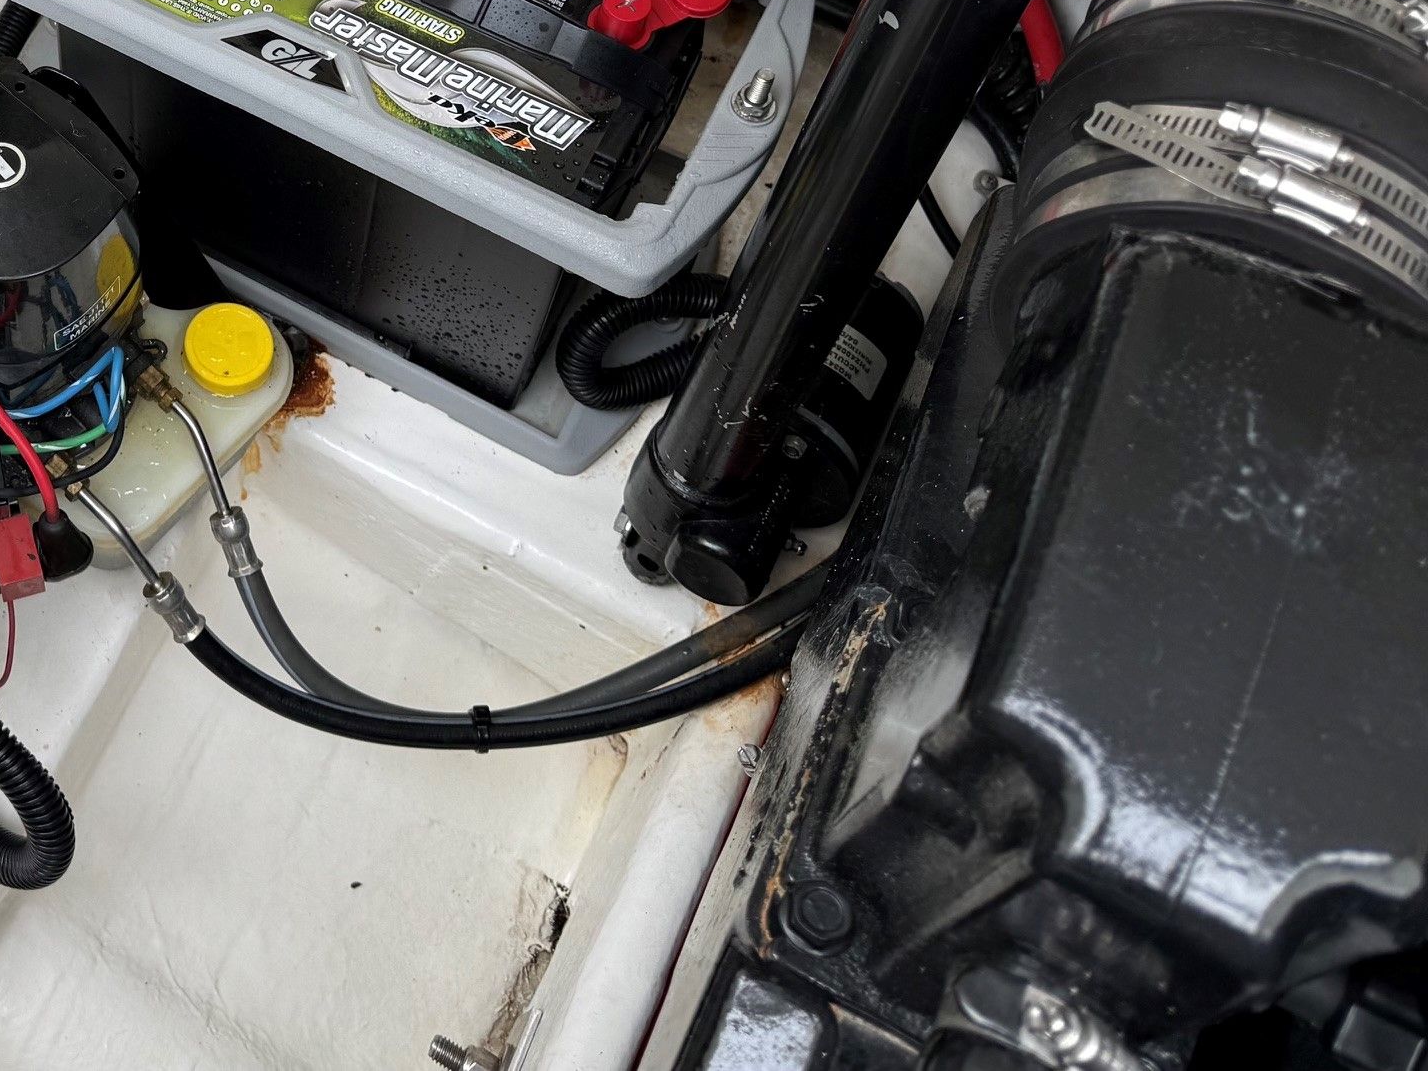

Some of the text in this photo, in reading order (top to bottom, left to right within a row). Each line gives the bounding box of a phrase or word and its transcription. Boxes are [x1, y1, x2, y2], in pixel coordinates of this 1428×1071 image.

[172, 1, 186, 11] THIS
[309, 6, 586, 149] Marine Master
[62, 316, 87, 337] SAE
[69, 298, 111, 341] MARINE
